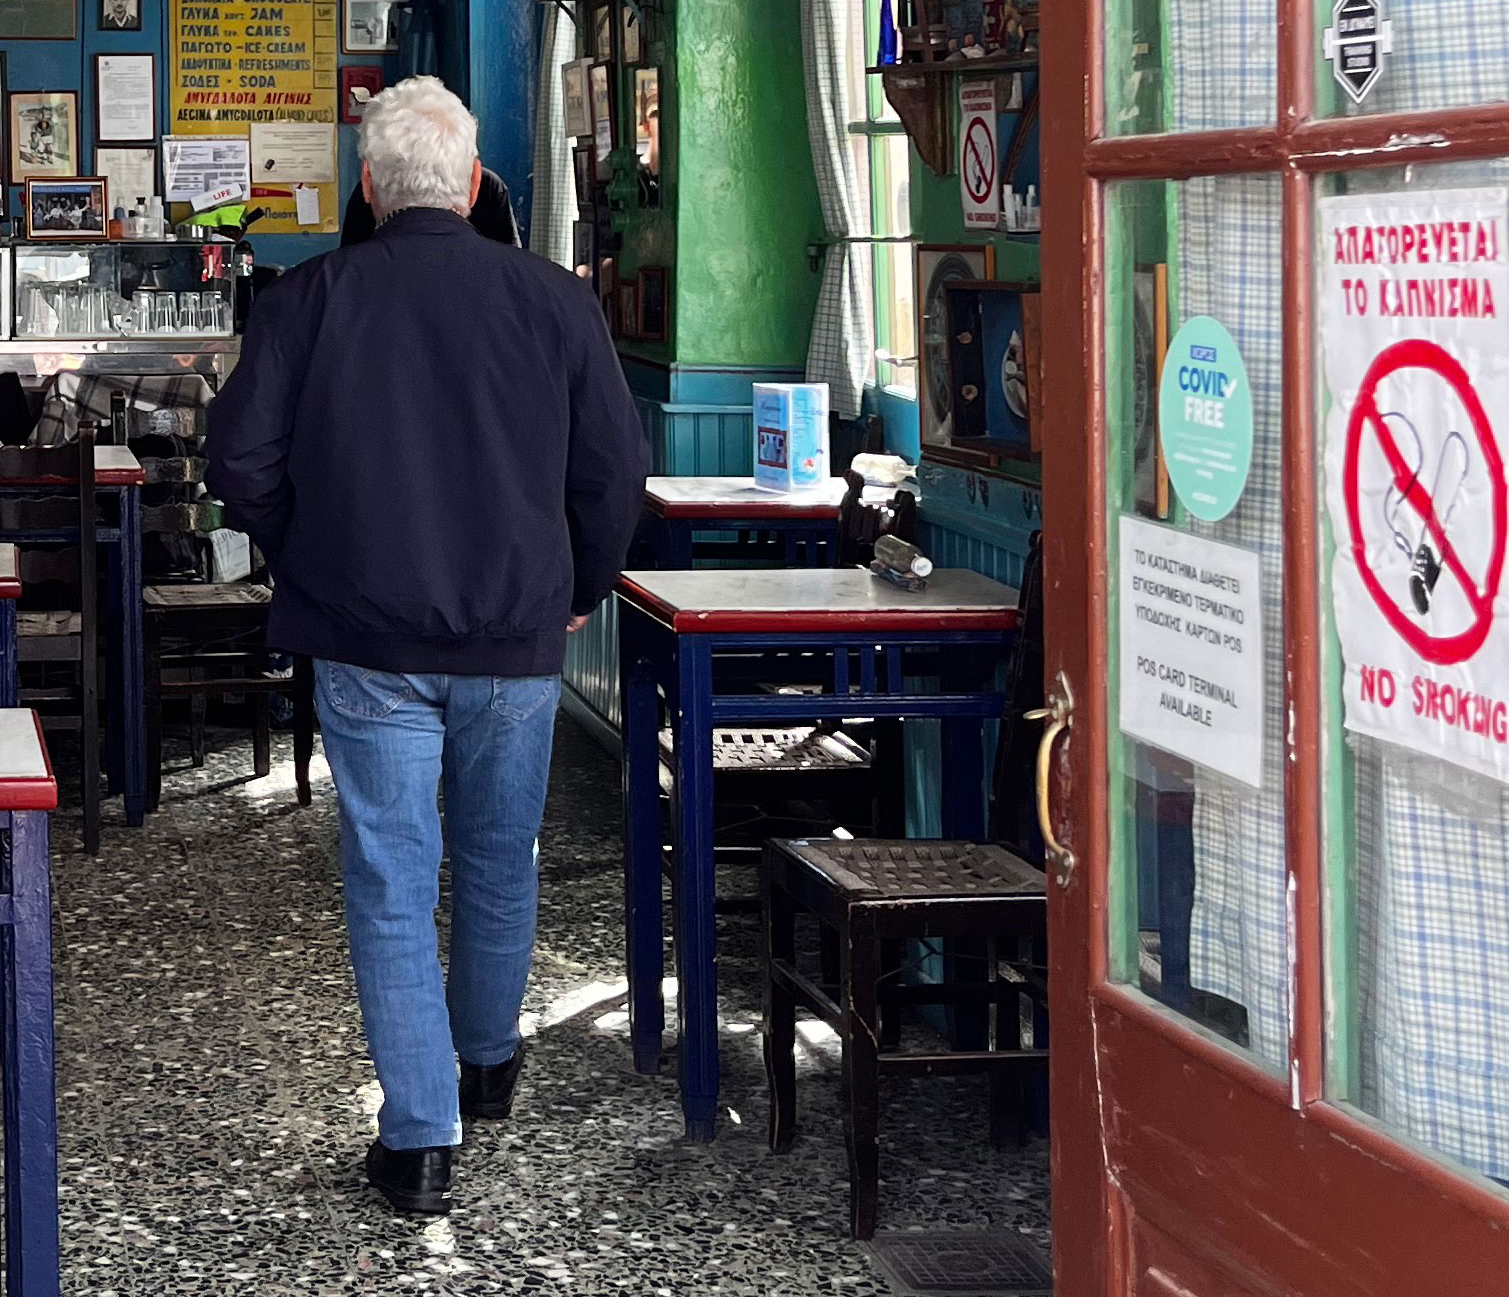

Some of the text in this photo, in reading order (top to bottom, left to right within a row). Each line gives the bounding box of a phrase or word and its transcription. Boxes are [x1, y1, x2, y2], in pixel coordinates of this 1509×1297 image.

[181, 7, 219, 20] ΓΛΥΚΑ
[250, 7, 284, 20] JAM
[181, 24, 219, 37] ΓΛΥΚΑ
[245, 25, 291, 37] CAKES
[181, 41, 232, 53] ΠΑΓΩΤΟ
[238, 58, 311, 71] REFRESHMENTS
[181, 75, 277, 88] ΣΟΔΕΣ SODA
[184, 92, 313, 105] ΑΜΥΓΔΑΛΟΤΑ ΑΙΓΙΝΗΣ
[177, 108, 212, 121] AEGINA
[212, 188, 232, 202] LIFE
[1334, 219, 1498, 265] ΑΠΑΓΟΡΕΥΕΤΑΙ
[1341, 278, 1496, 318] ΤΟ ΚΑΠΝΙΣΜΑ
[1178, 365, 1228, 398] COVID
[1184, 396, 1225, 429] FREE
[1223, 634, 1242, 653] POS
[1137, 655, 1238, 709] POS CARD TERMINAL
[1360, 663, 1396, 708] NO
[1159, 692, 1212, 727] AVAILABLE
